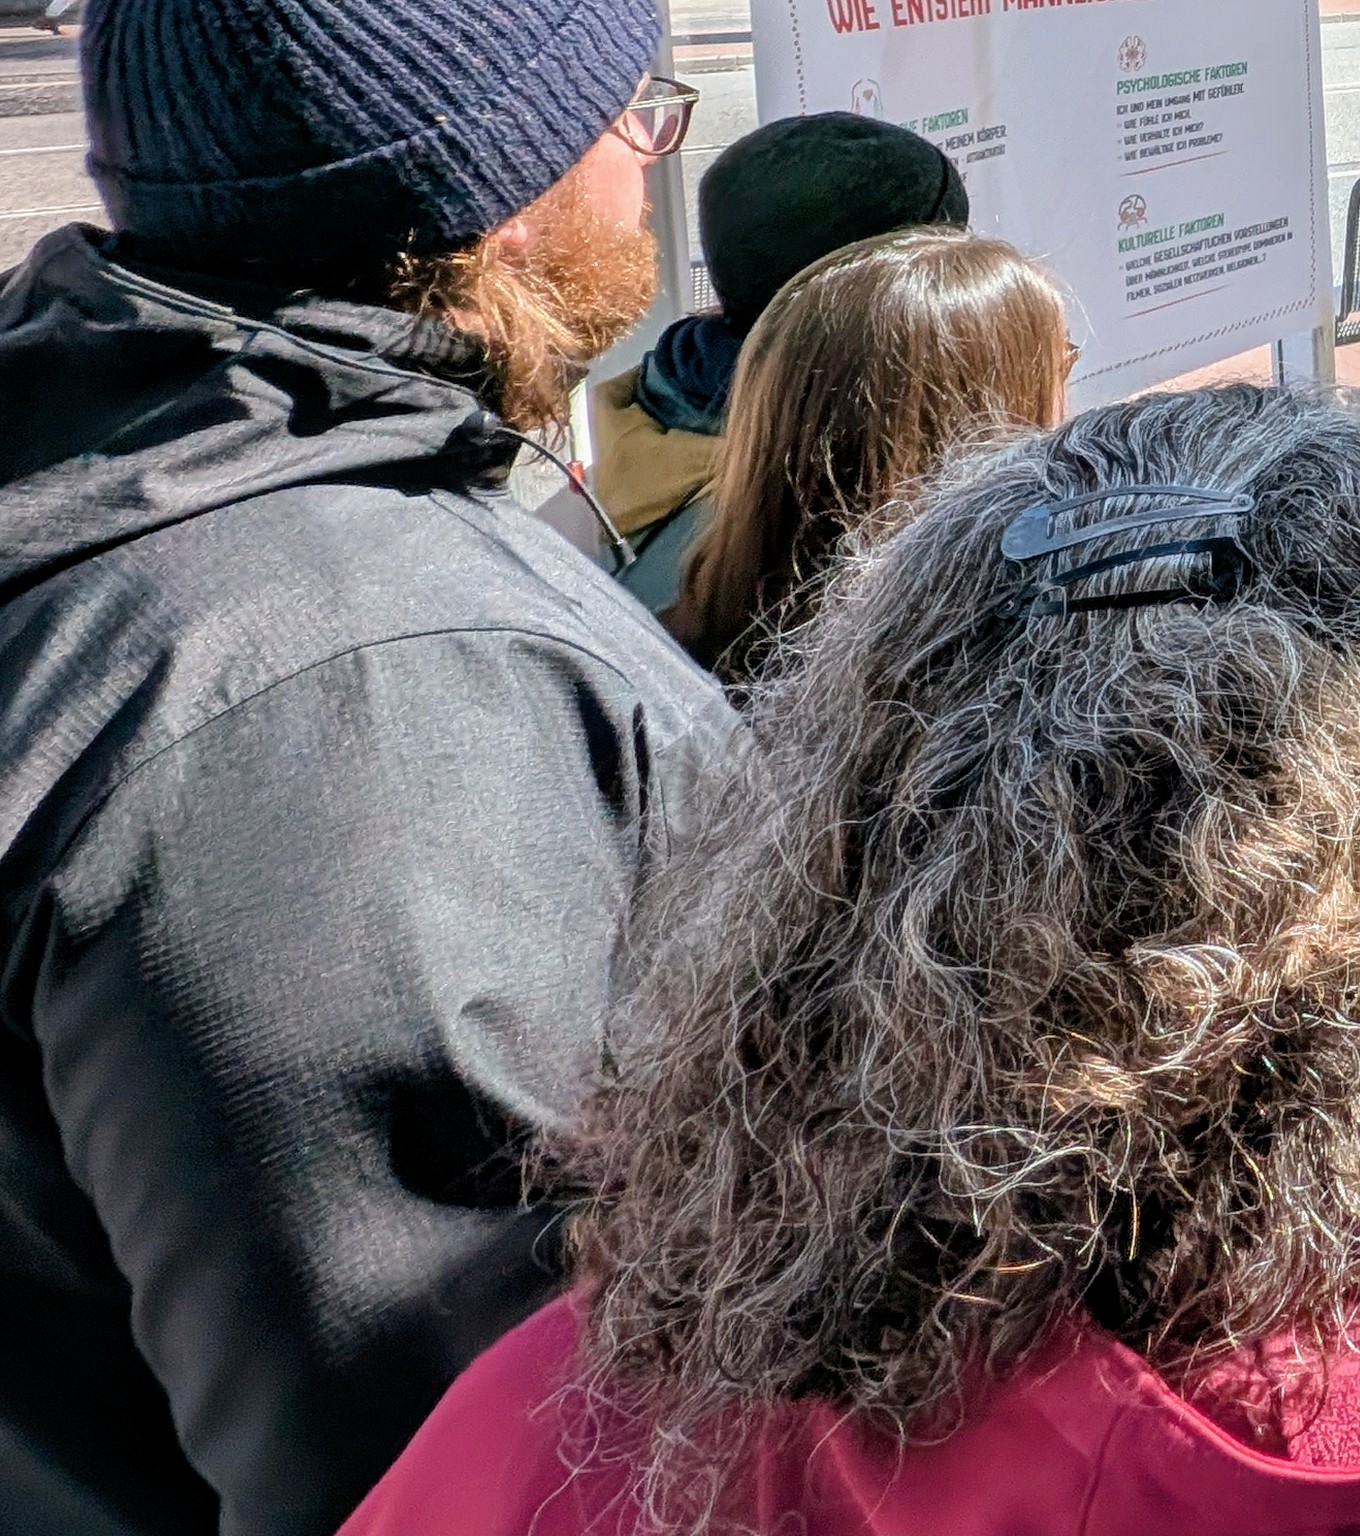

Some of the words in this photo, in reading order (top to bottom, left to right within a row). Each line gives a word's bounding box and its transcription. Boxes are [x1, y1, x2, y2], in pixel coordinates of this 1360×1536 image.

[1117, 68, 1202, 96] PSYCHOLOGISCHE
[1204, 61, 1248, 82] FAKTOREN
[1117, 225, 1176, 253] KULTURELLE
[1179, 212, 1225, 238] FAKTOREN
